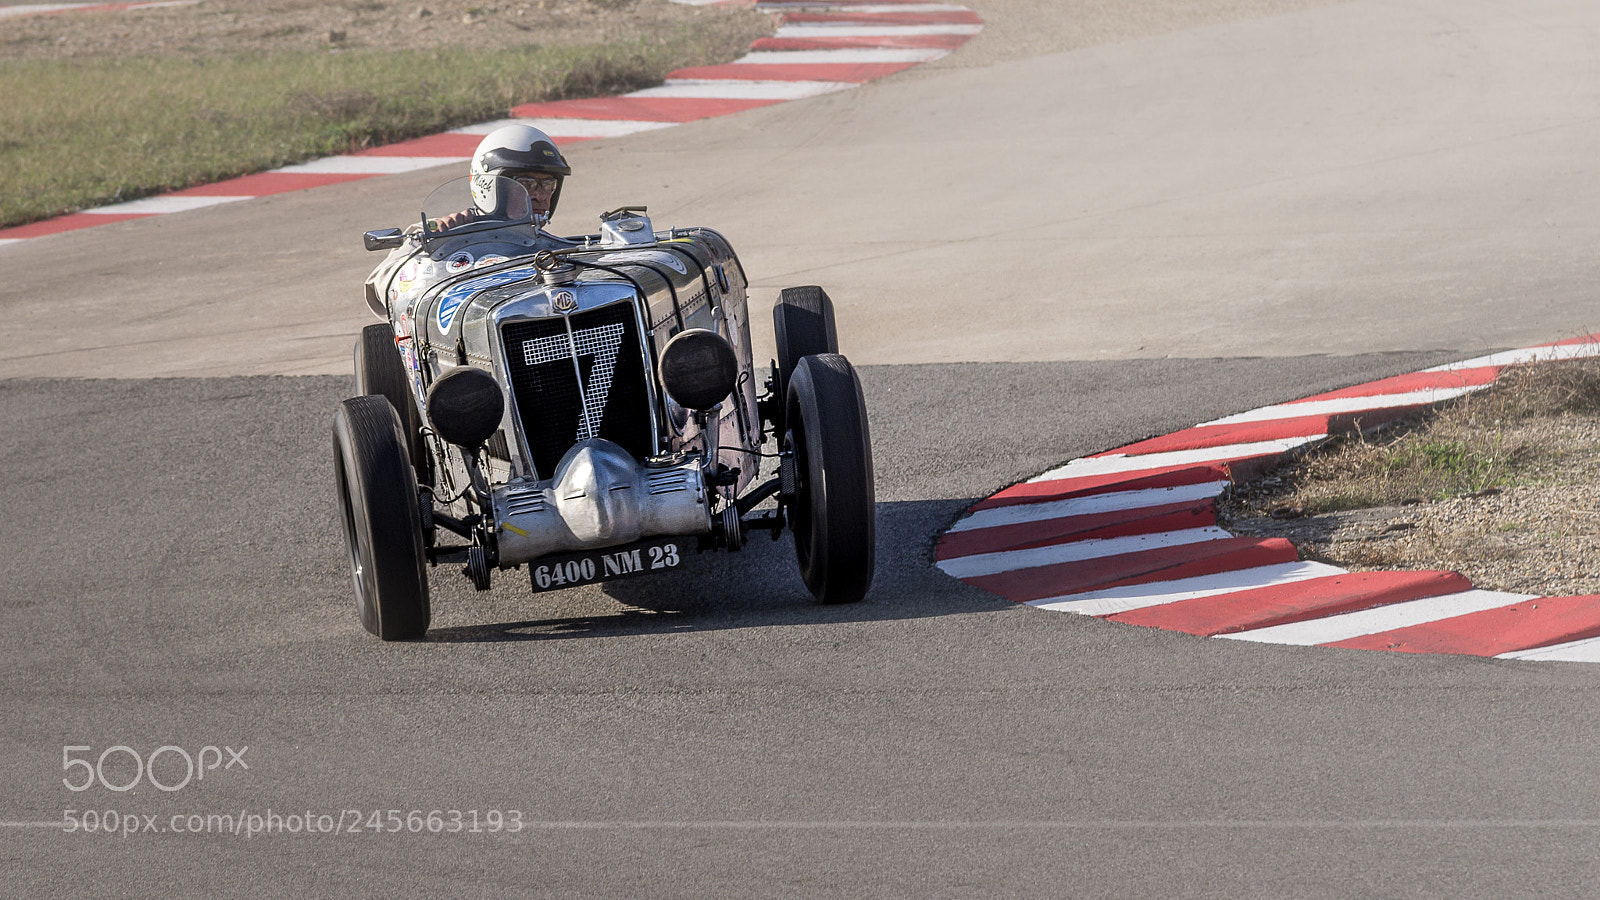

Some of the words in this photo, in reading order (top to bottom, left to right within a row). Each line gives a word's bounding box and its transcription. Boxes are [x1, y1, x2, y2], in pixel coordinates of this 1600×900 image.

[556, 292, 571, 309] MG
[522, 322, 624, 443] 7
[534, 558, 596, 589] 6400
[601, 549, 644, 577] NM
[648, 543, 680, 570] 23
